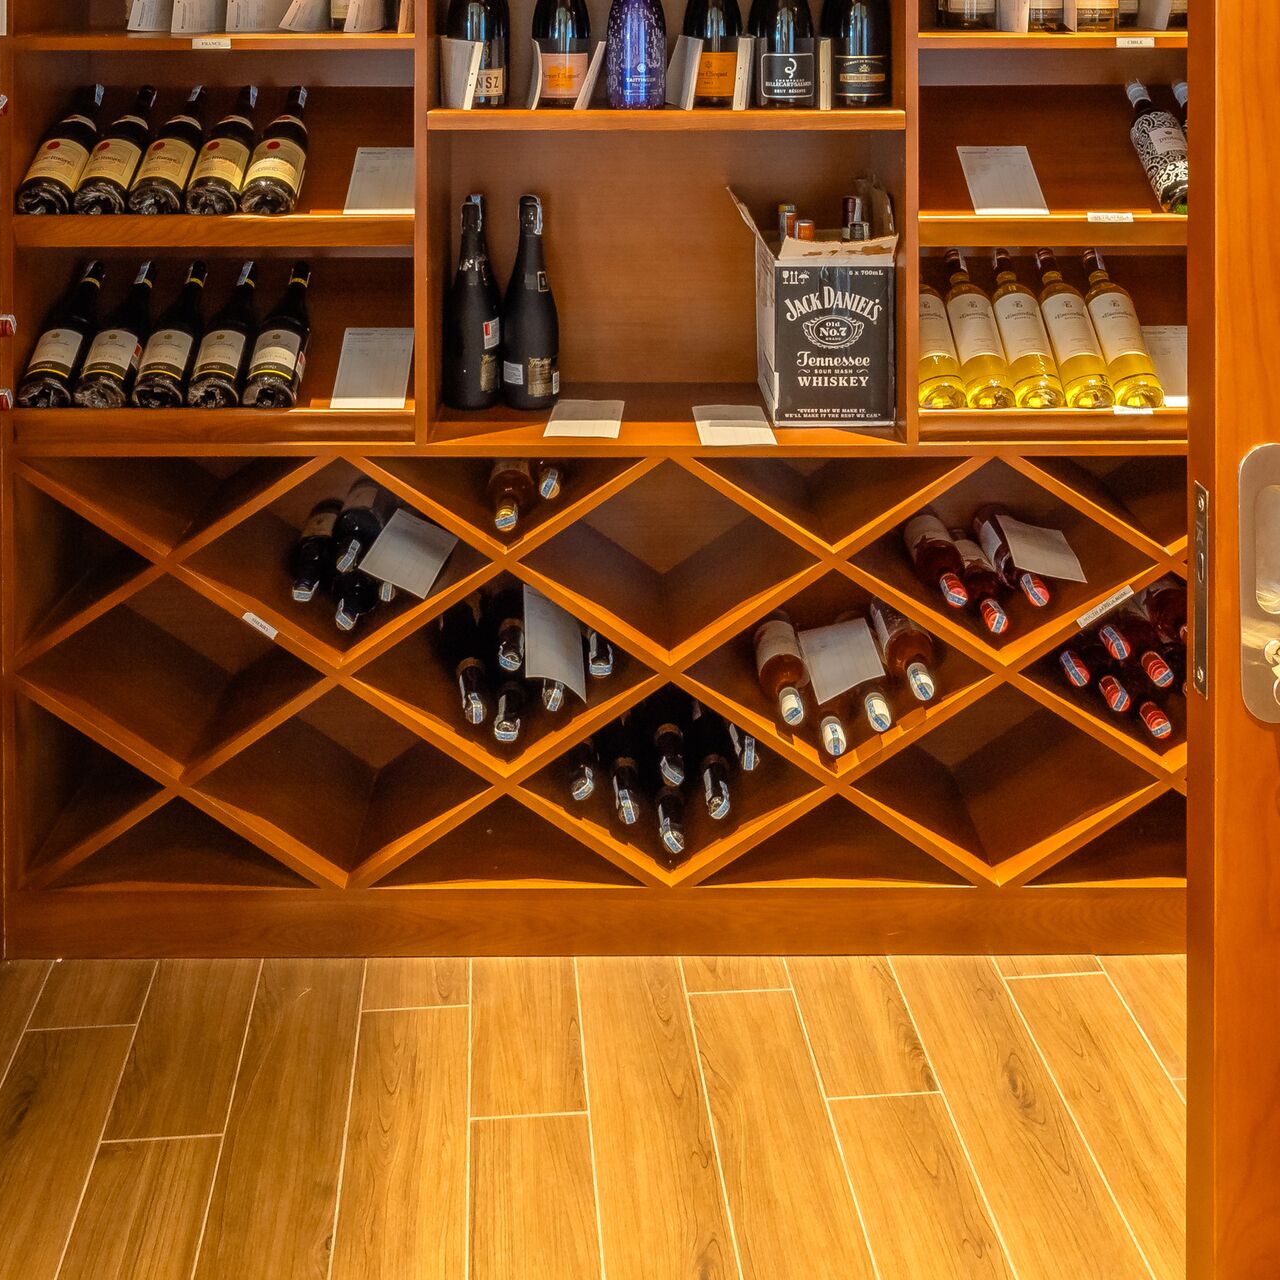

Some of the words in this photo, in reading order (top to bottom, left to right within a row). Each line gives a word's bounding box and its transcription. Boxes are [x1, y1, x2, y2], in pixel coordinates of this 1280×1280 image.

[784, 292, 822, 321] JACK
[823, 286, 882, 321] DANIEL'S
[820, 327, 847, 336] No.7
[796, 351, 870, 367] Tennessee
[797, 376, 869, 387] WHISKEY
[251, 617, 269, 631] SHERRY
